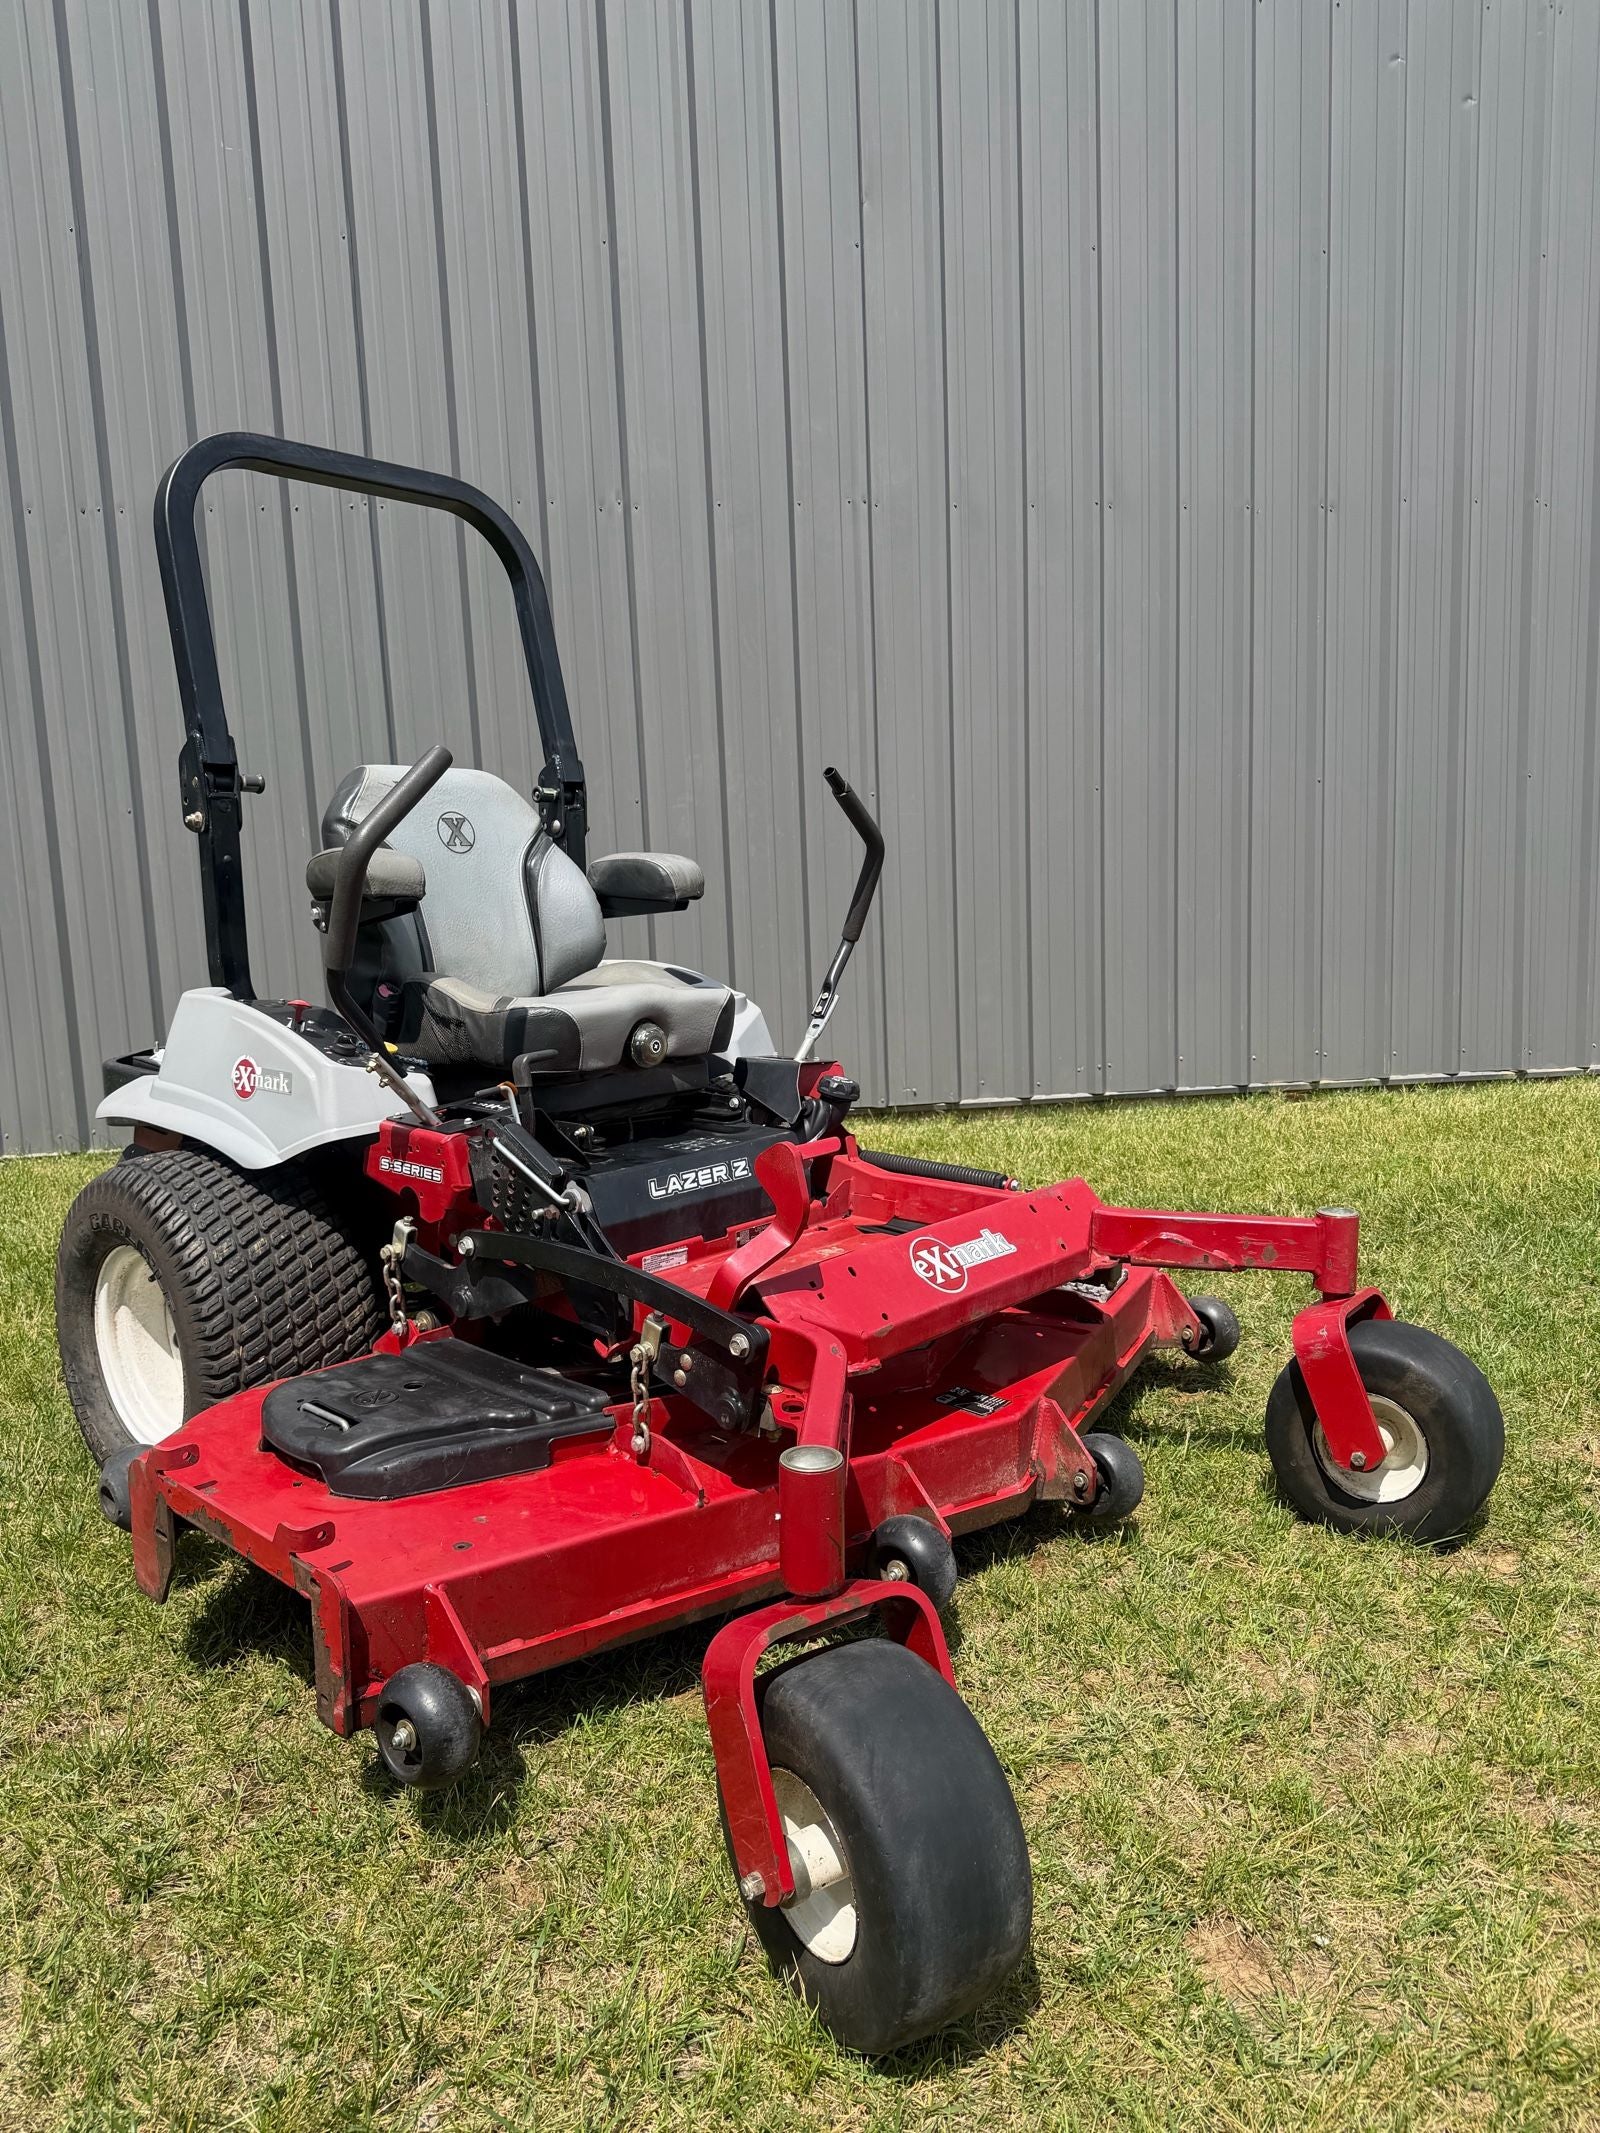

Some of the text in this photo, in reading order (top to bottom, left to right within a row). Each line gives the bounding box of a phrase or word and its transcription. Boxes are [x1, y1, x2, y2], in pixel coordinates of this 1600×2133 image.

[233, 1065, 290, 1094] eXmark
[647, 1157, 751, 1200] LAZER Z
[913, 1229, 1017, 1285] eXmark
